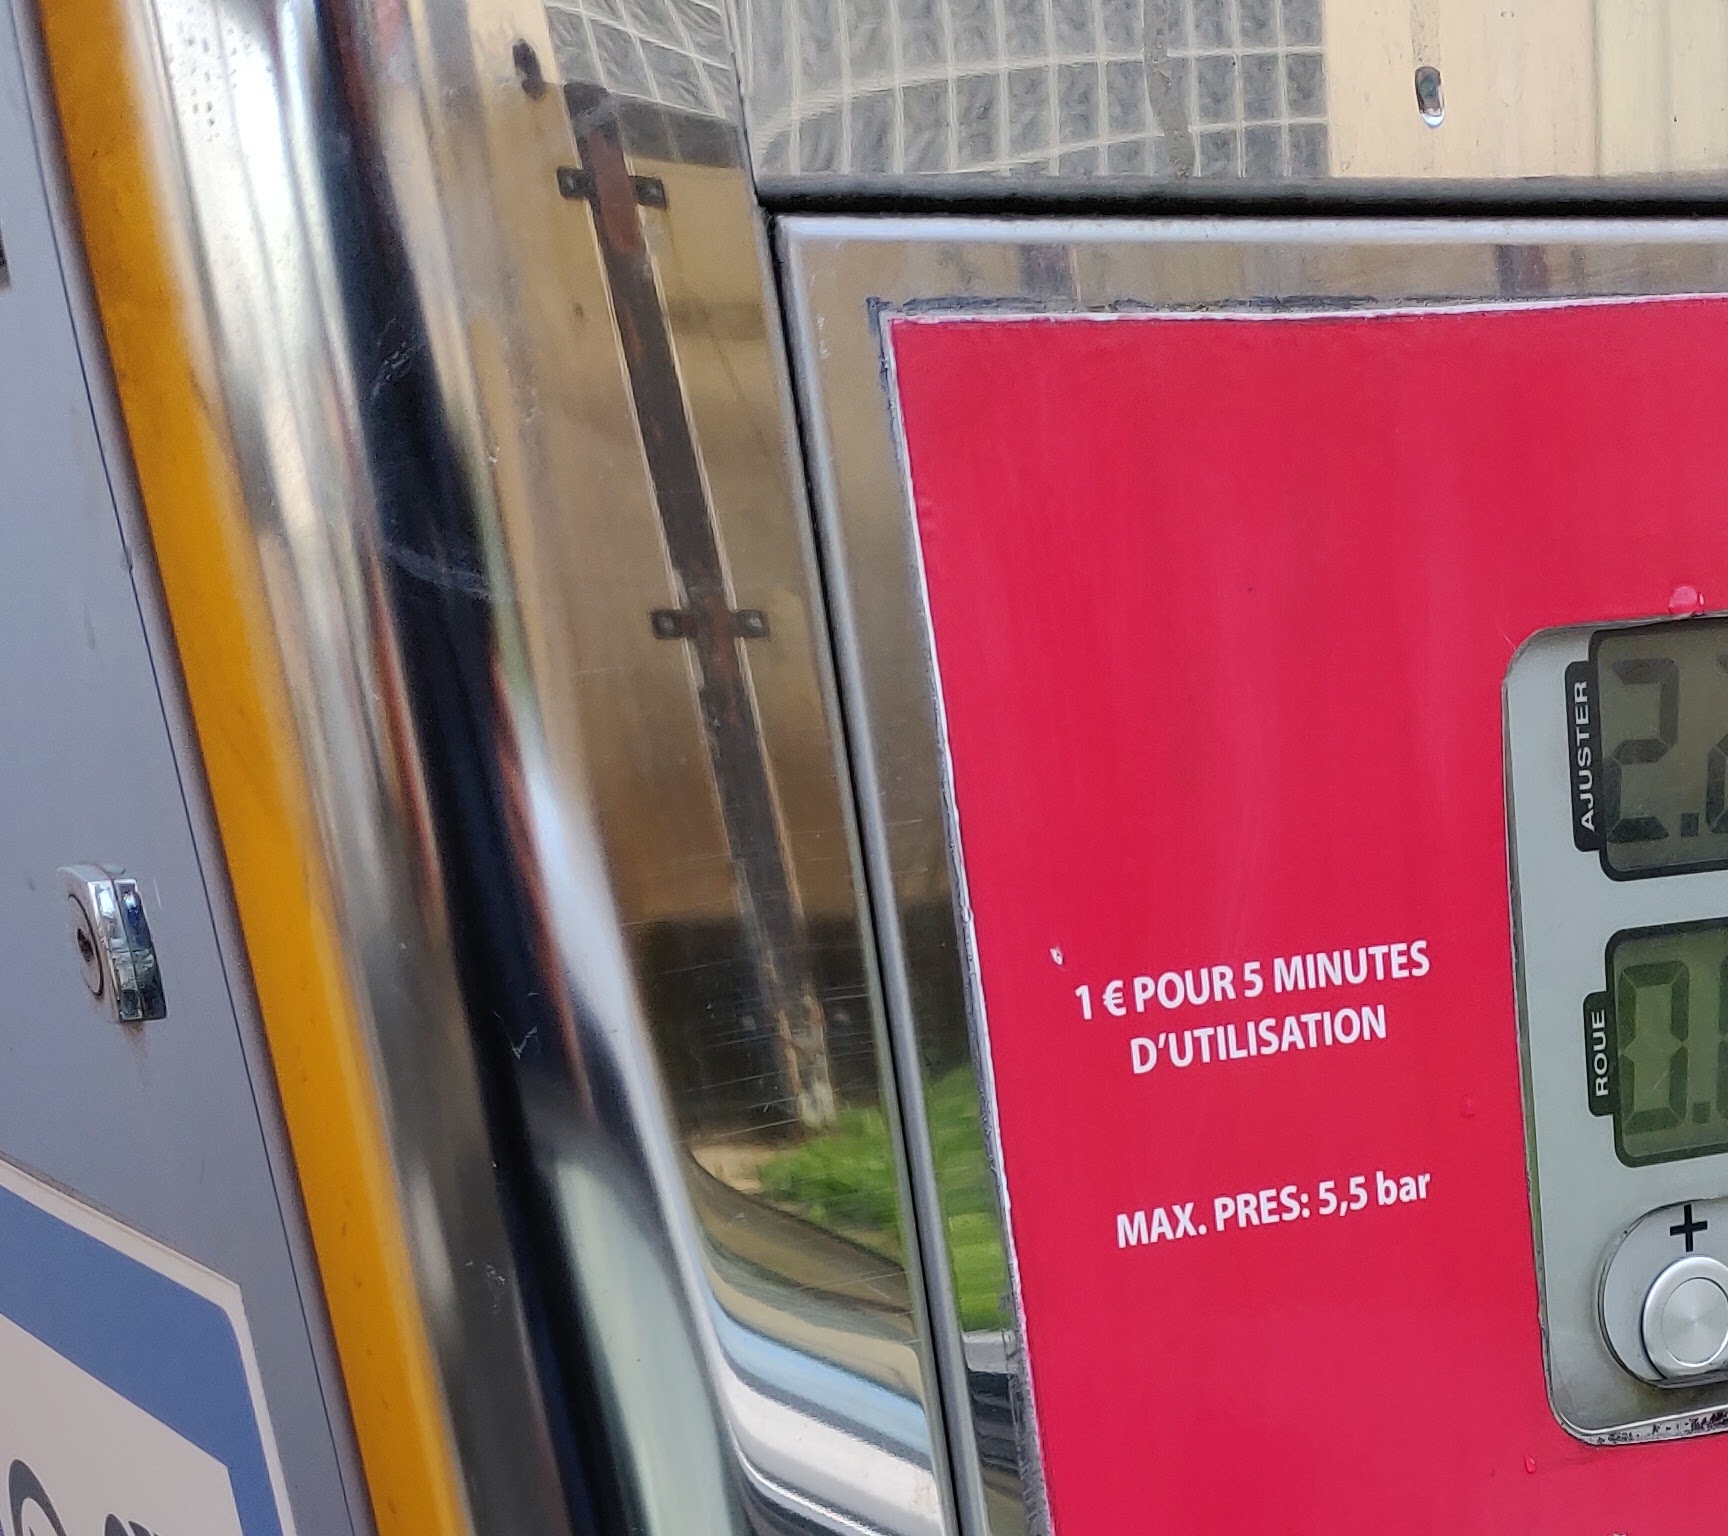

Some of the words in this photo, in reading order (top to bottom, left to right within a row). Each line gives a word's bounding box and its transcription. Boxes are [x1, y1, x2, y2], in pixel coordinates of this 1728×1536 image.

[1573, 680, 1596, 832] AJUSTER
[1074, 984, 1092, 1020] 1
[1101, 979, 1126, 1016] €
[1132, 964, 1236, 1012] POUR
[1243, 960, 1263, 997] 5
[1273, 939, 1430, 993] MINUTES
[1130, 1003, 1386, 1074] D'UTILISATION
[1593, 1008, 1610, 1098] ROUE
[1116, 1201, 1207, 1248] MAX.
[1213, 1184, 1310, 1231] PRES:
[1318, 1175, 1368, 1216] 5,5
[1375, 1170, 1430, 1205] bar
